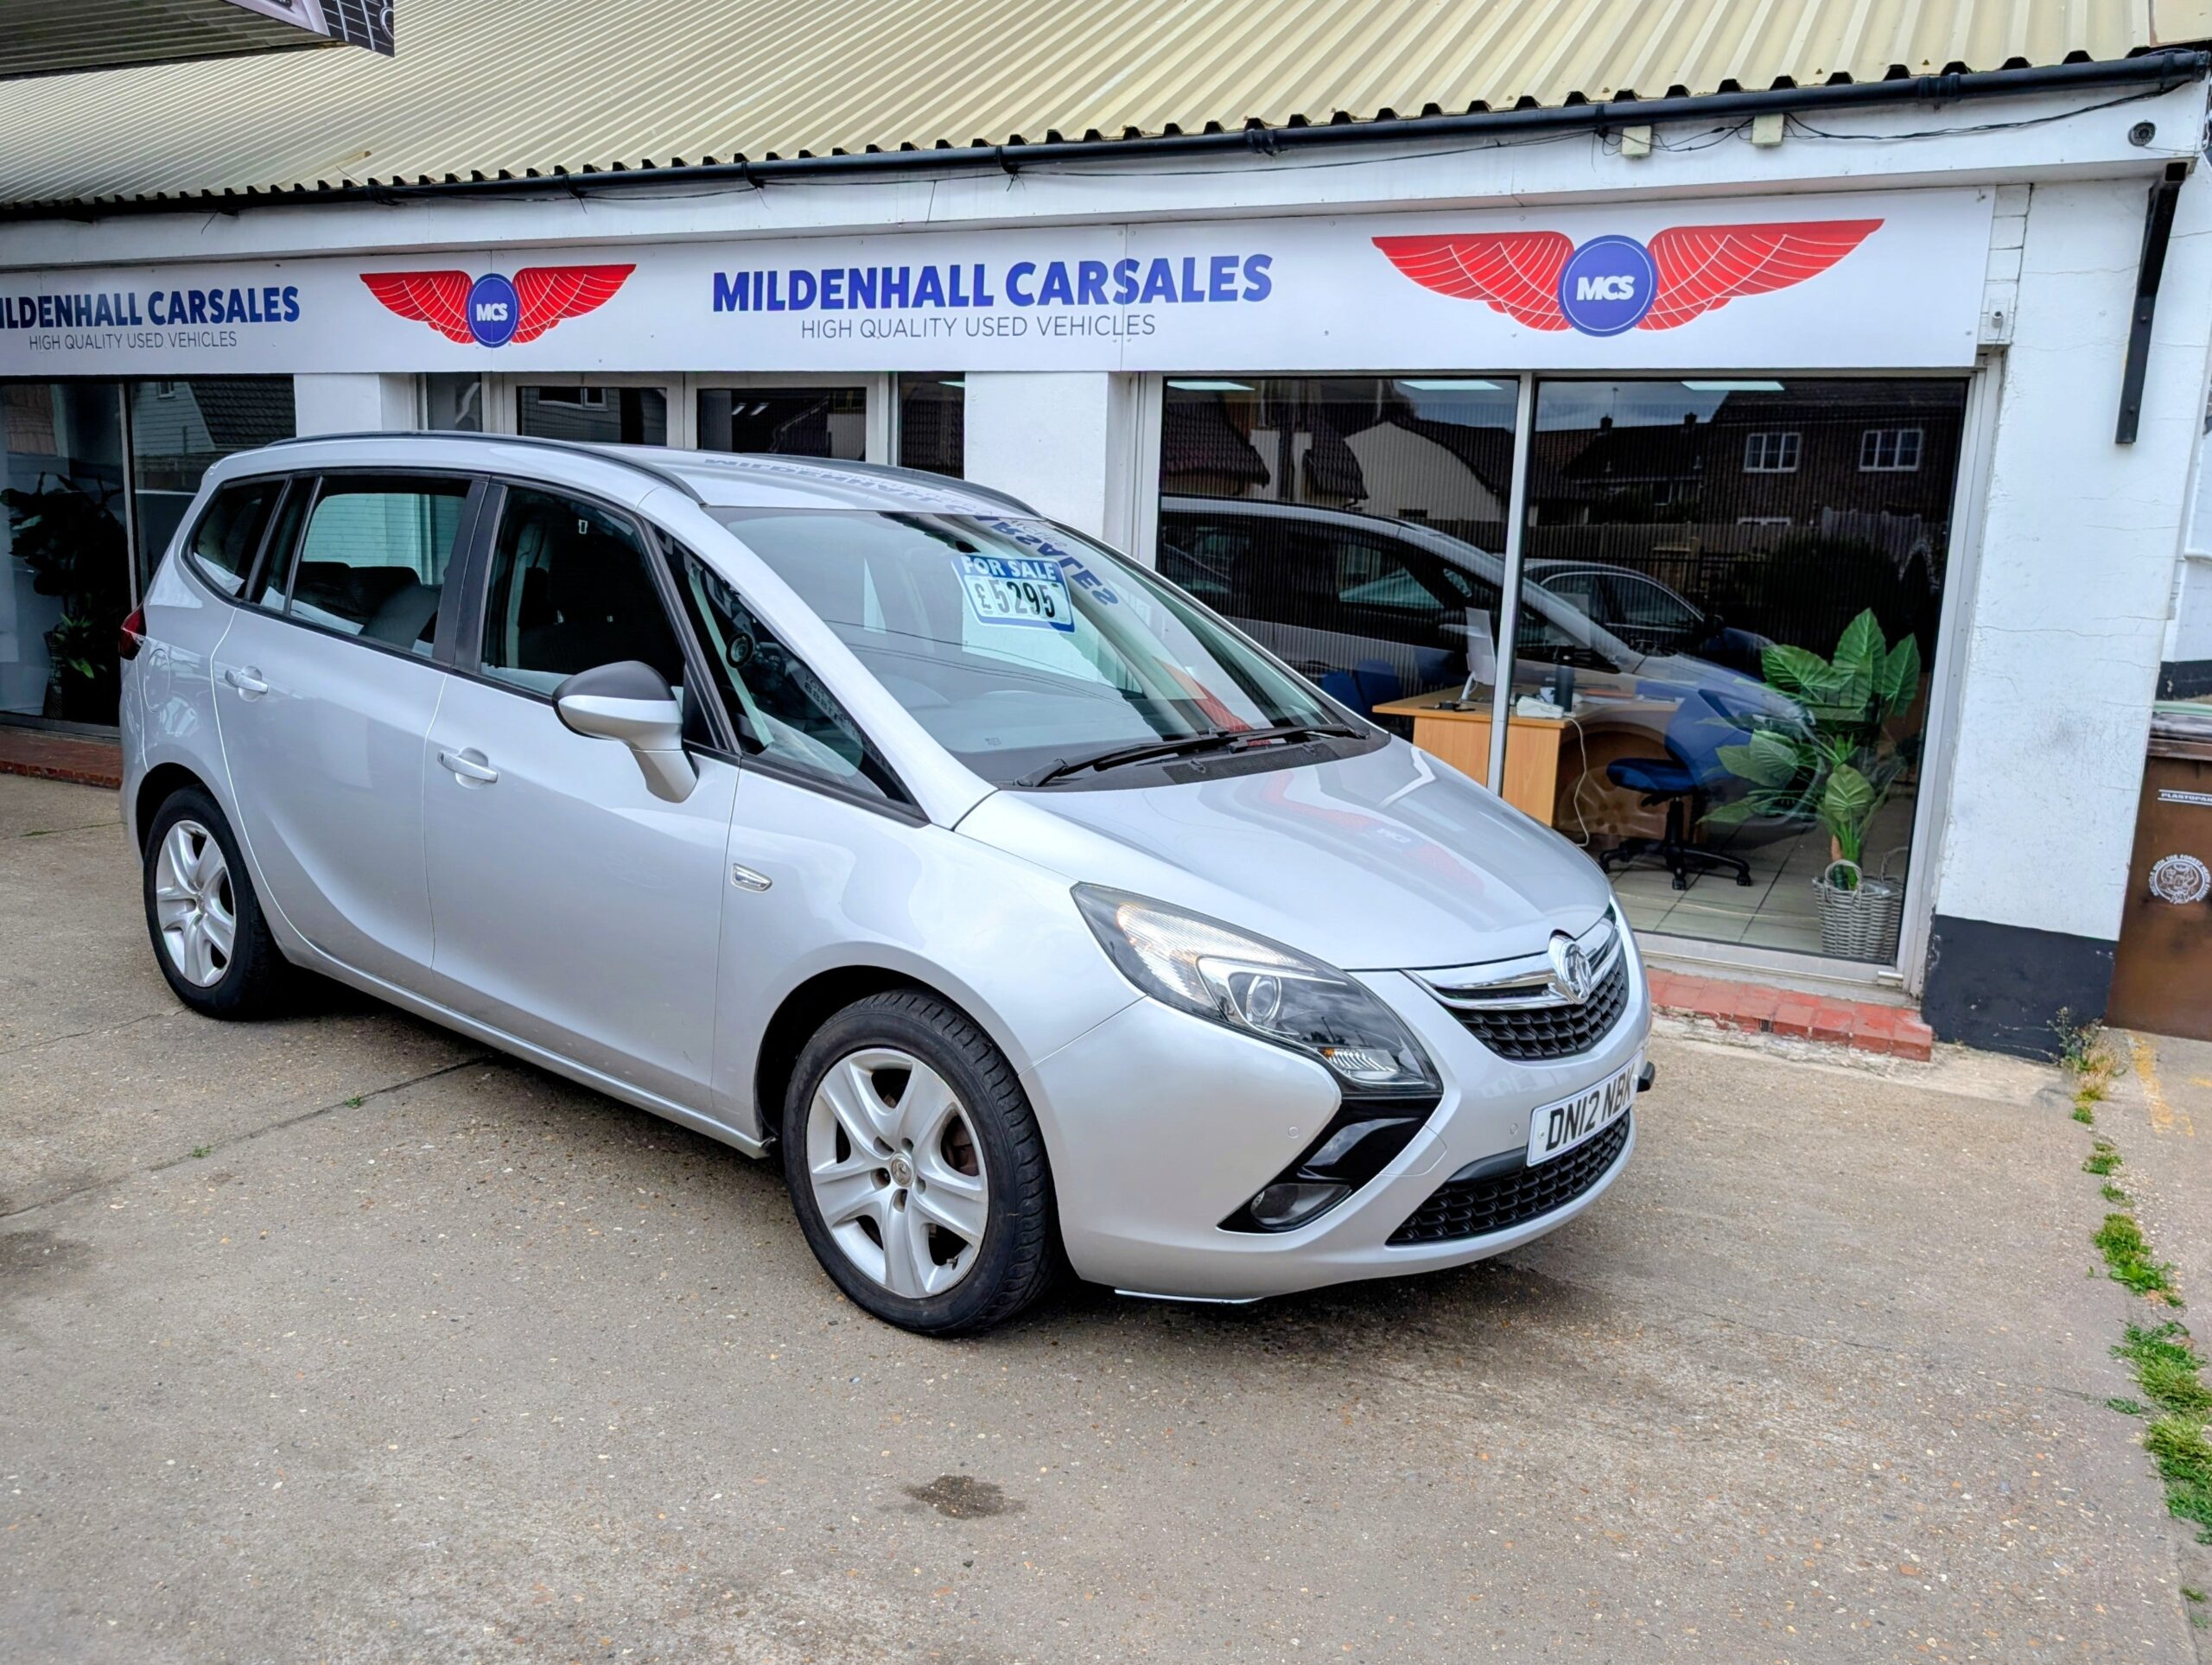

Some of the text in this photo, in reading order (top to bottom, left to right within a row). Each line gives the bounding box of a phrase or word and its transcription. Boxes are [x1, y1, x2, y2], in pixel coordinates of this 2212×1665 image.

[713, 253, 1274, 312] MILDENHALL CARSALES
[1576, 275, 1636, 301] MCS
[148, 286, 300, 326] CARSALES
[476, 302, 508, 321] MCS
[801, 314, 1156, 339] HIGH QUALITY USED VEHICLES
[29, 331, 237, 350] HIGH QUALITY USED VEHICLES
[960, 556, 1057, 581] FOR SALE
[974, 579, 1056, 618] £5295
[1546, 1063, 1636, 1152] DN12 NBK
